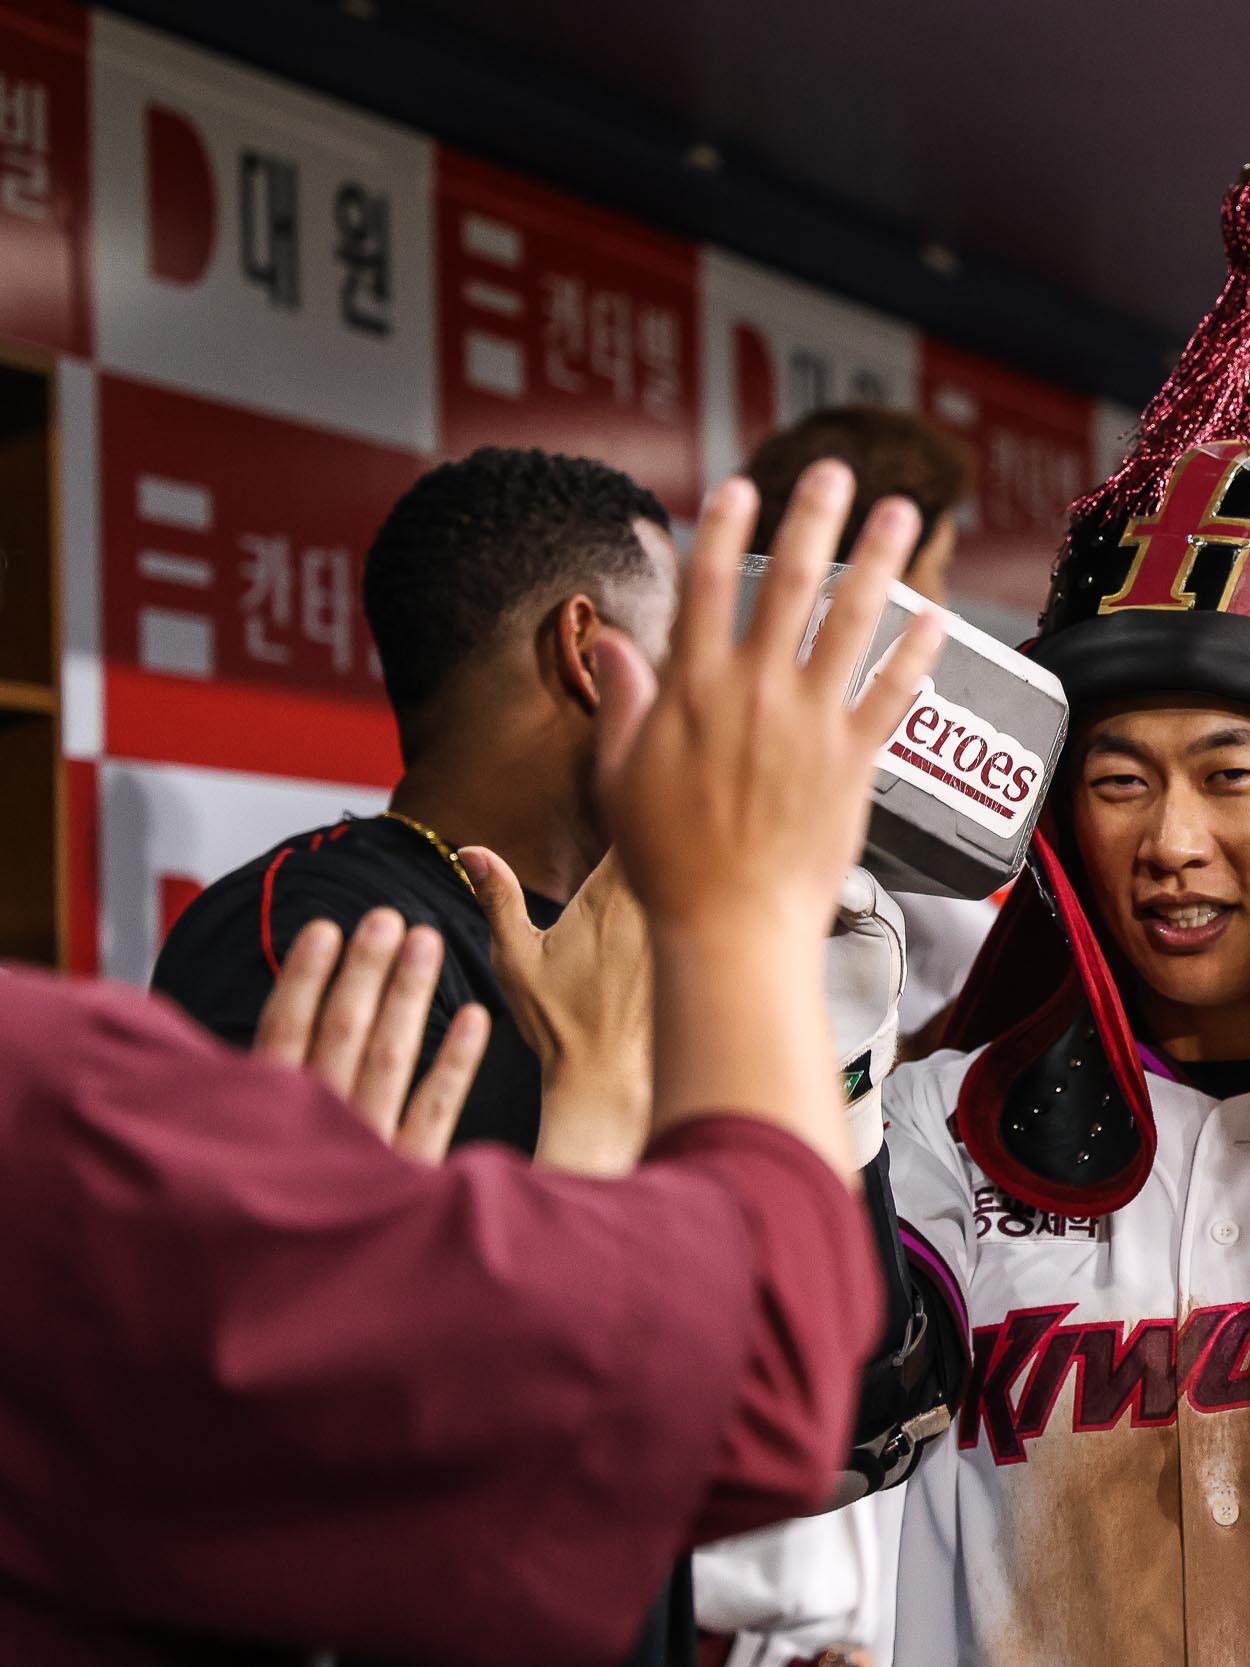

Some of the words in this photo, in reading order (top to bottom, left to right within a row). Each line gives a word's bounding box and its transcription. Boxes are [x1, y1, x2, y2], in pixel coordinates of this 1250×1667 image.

[238, 145, 394, 338] 대원
[236, 532, 386, 681] 칸타
[893, 690, 1038, 803] eroes
